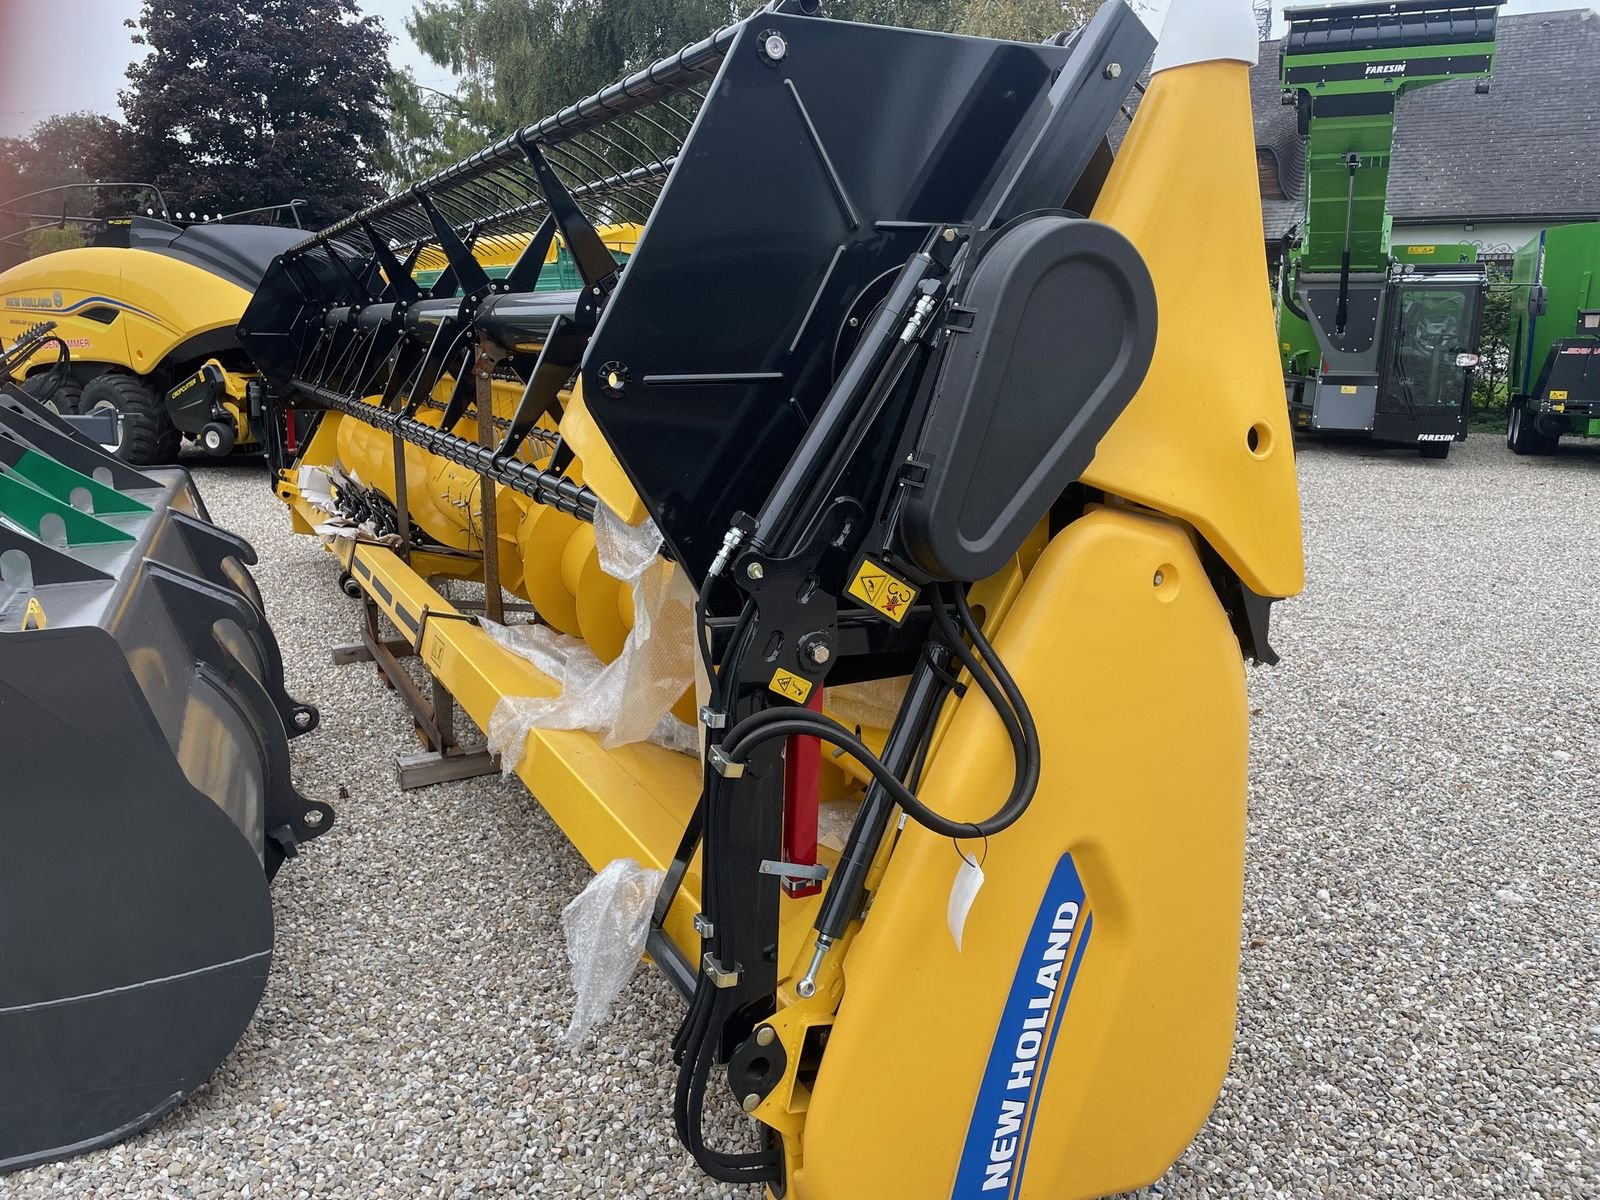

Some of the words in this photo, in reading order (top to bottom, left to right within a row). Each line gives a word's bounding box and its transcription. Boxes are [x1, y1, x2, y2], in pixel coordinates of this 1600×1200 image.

[1365, 64, 1406, 74] FARESIN
[1417, 433, 1455, 441] FARESIN
[982, 1100, 1025, 1191] NEW
[1006, 901, 1079, 1090] HOLLAND
